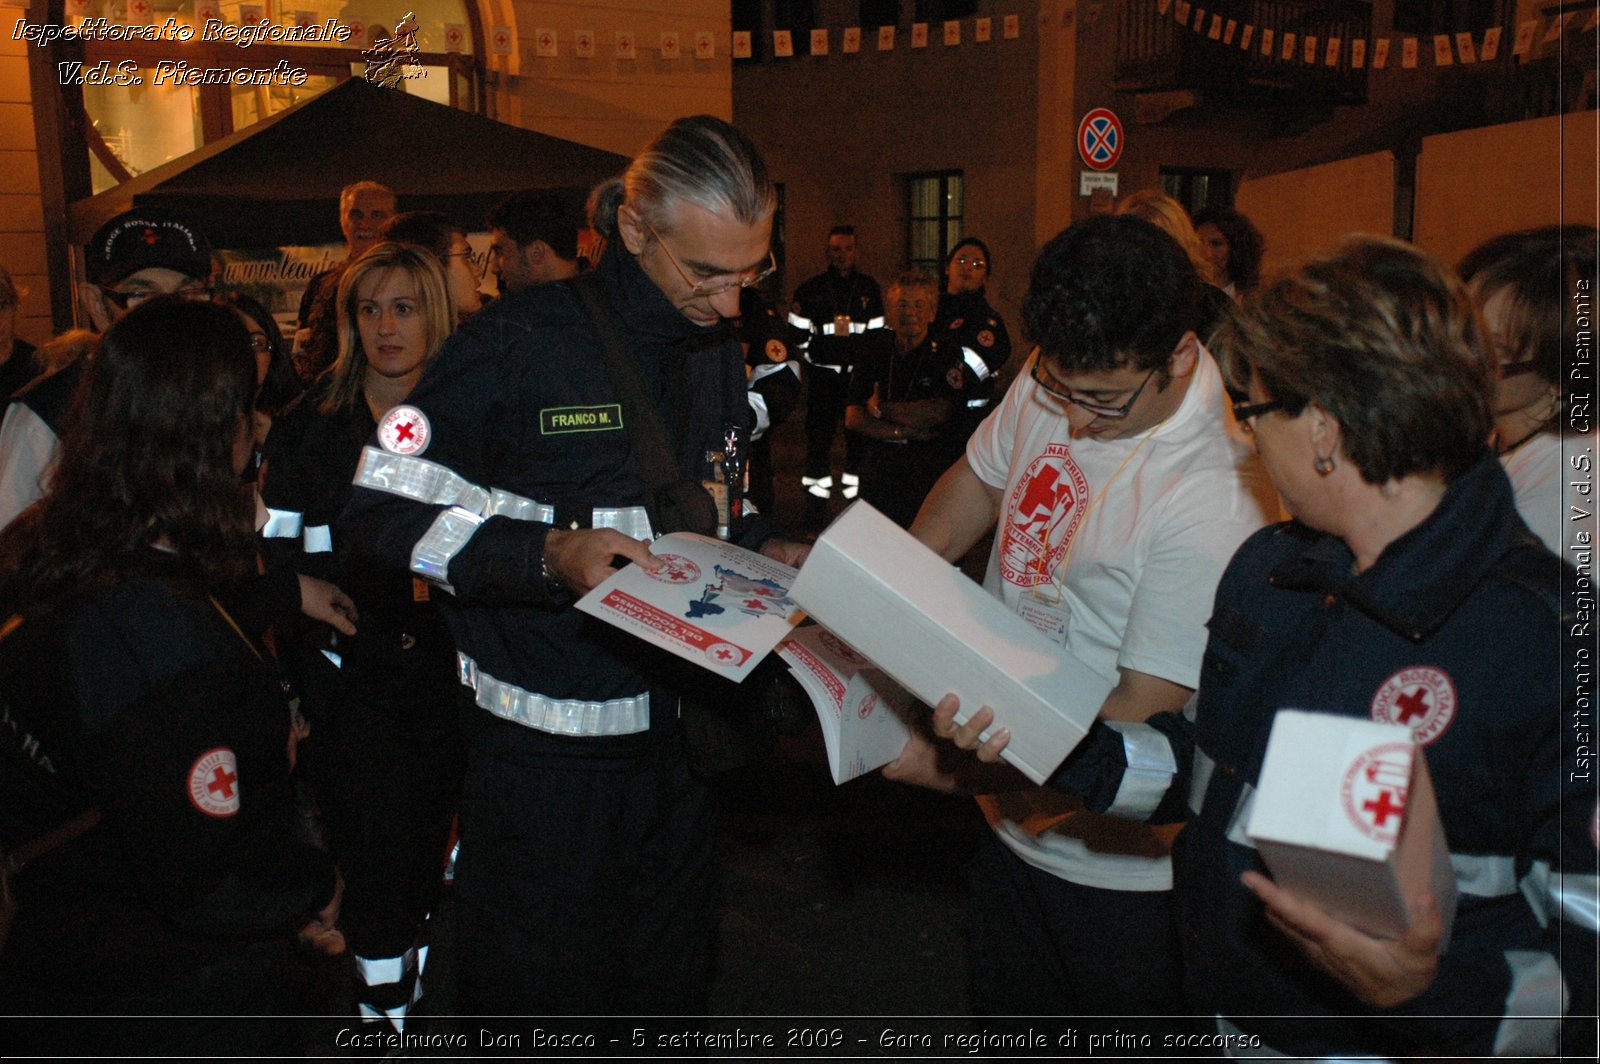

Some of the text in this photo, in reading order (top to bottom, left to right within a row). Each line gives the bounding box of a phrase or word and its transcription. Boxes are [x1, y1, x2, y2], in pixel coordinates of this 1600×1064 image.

[551, 412, 613, 428] FRANCO M.
[1012, 470, 1031, 500] GARA
[1065, 458, 1087, 495] PRIMO
[1056, 497, 1088, 561] SOCCORSO
[609, 594, 681, 630] SOCCORSO
[614, 603, 689, 643] VOLONTARI
[681, 626, 705, 643] DEL
[1399, 670, 1445, 688] ROSSA
[1417, 688, 1452, 741] ITALIAN
